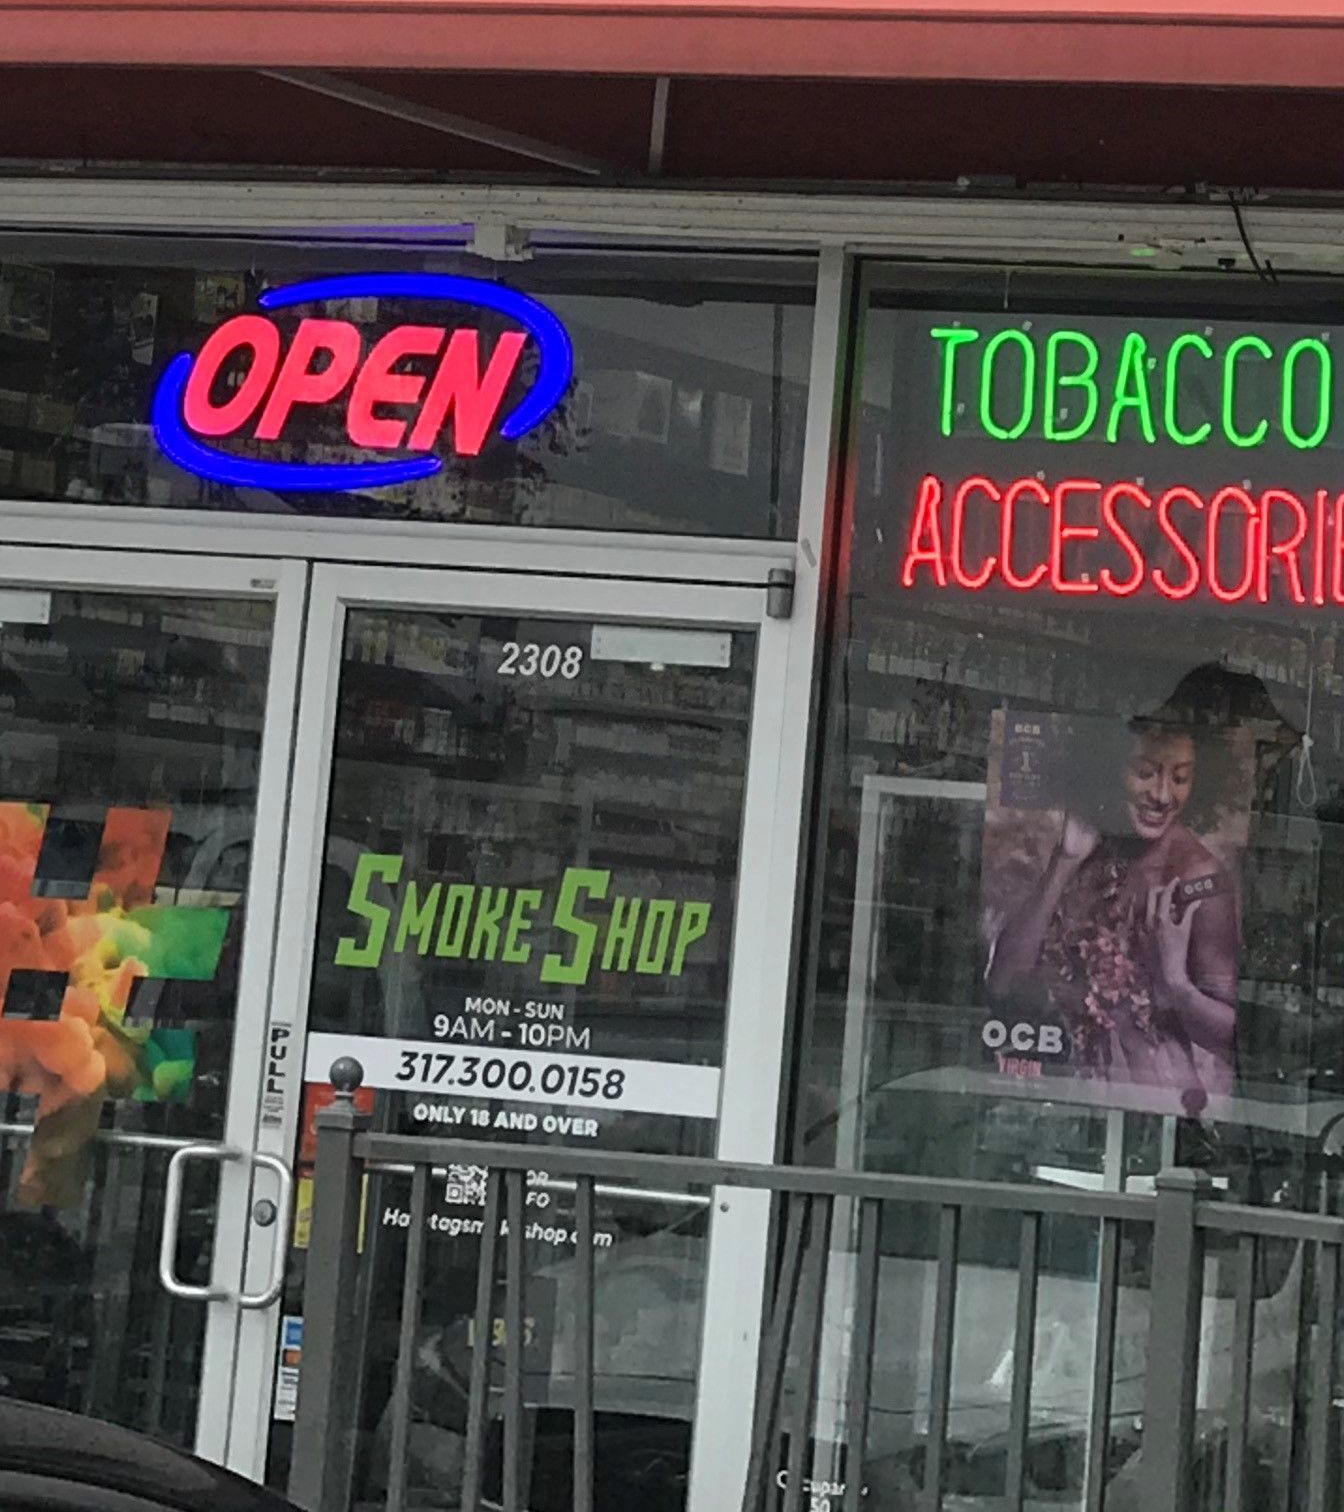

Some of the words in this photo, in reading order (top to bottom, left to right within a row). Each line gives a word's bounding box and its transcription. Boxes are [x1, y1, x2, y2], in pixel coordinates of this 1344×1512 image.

[182, 313, 526, 457] OPEN
[931, 328, 1333, 448] TOBACCO
[498, 642, 583, 679] 2308
[465, 996, 509, 1017] MON
[525, 1001, 565, 1021] SUN
[433, 1014, 494, 1041] 9AM
[518, 1022, 591, 1050] 10PM
[982, 1020, 1064, 1054] OCB
[267, 1027, 290, 1094] PULL
[395, 1050, 625, 1101] 317.300.0158
[413, 1104, 465, 1127] ONLY
[470, 1109, 491, 1128] 18
[493, 1111, 539, 1132] AND
[542, 1115, 598, 1138] OVER
